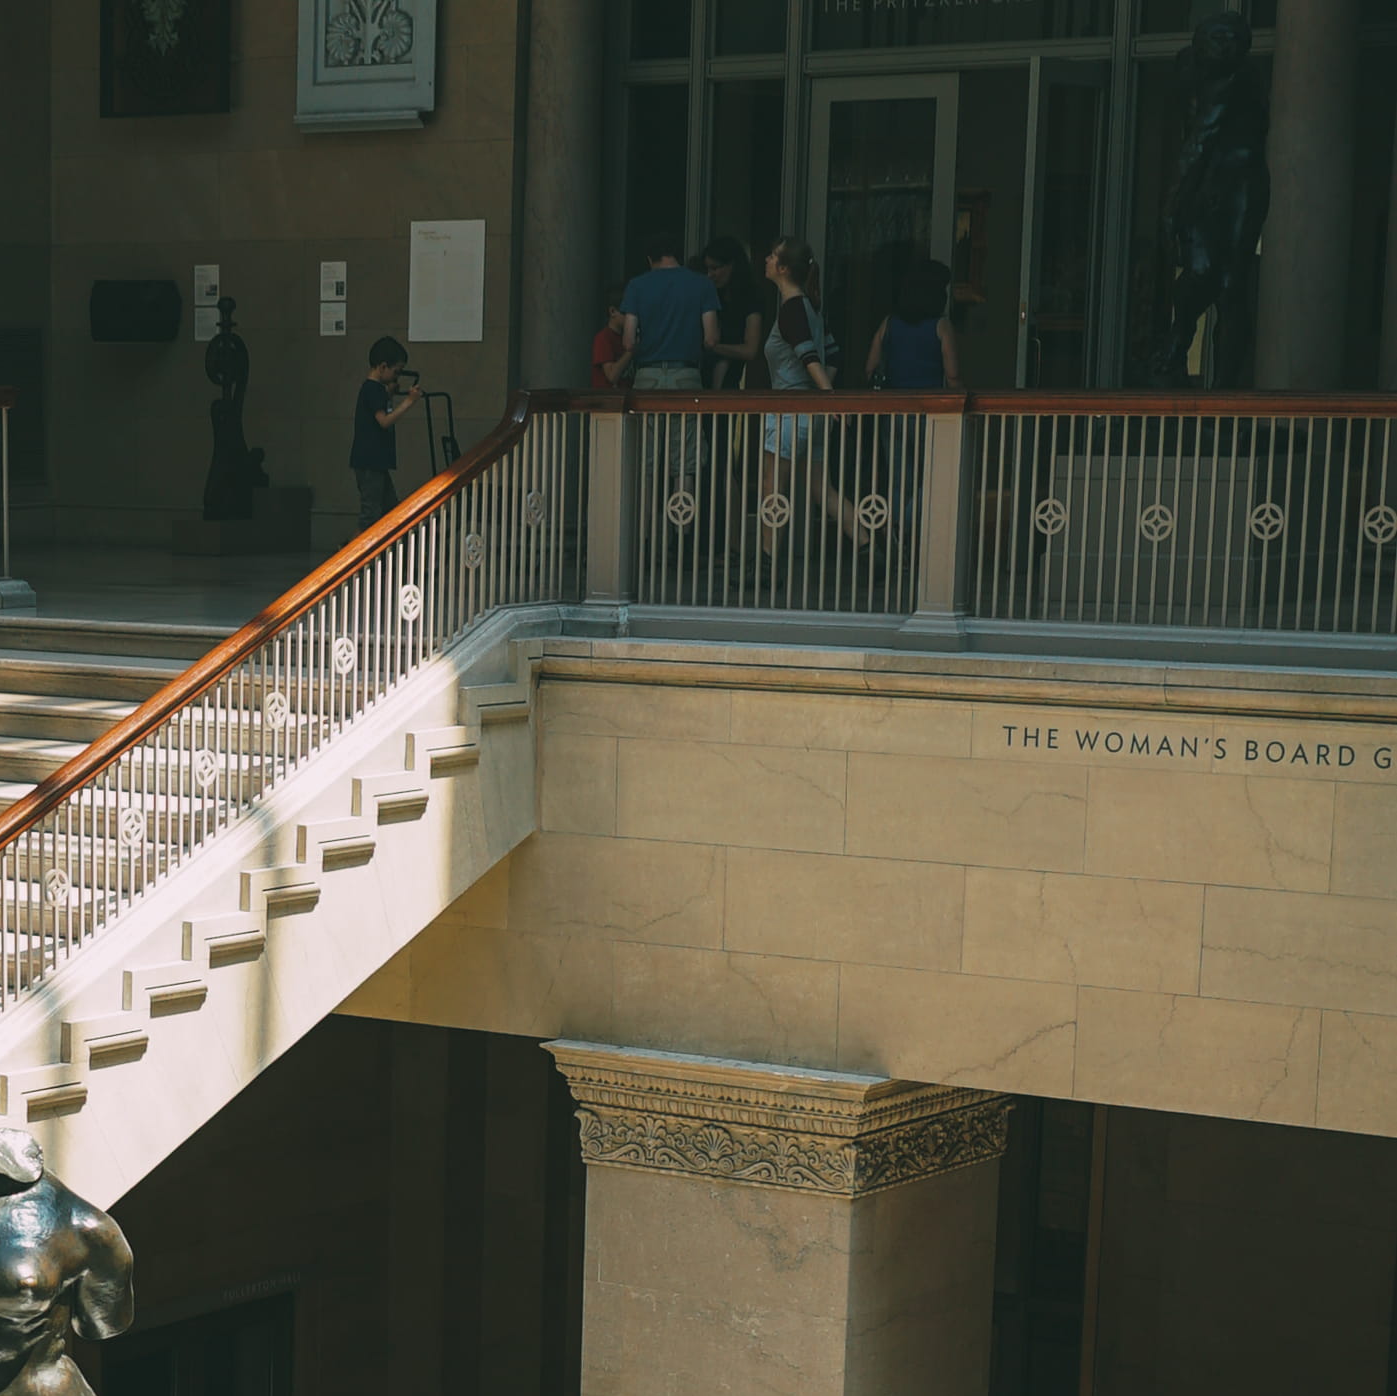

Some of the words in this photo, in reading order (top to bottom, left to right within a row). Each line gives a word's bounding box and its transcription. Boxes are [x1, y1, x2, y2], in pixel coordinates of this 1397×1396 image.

[1002, 725, 1059, 750] THE
[1075, 729, 1228, 760] WOMAN'S
[1245, 739, 1356, 767] BOARD
[1373, 747, 1392, 769] G
